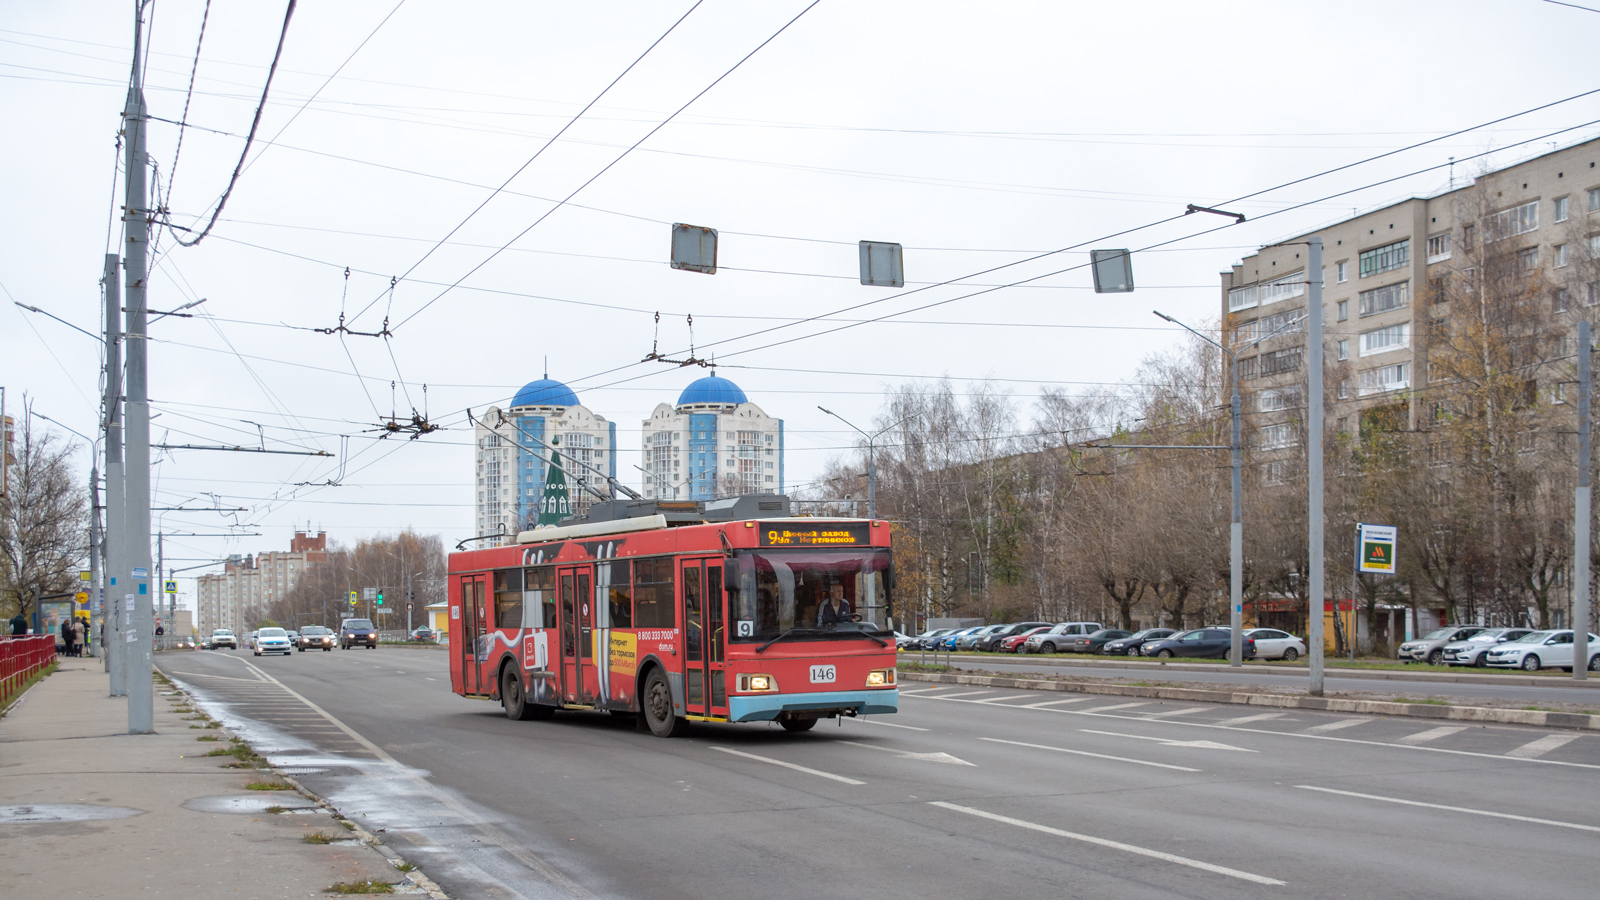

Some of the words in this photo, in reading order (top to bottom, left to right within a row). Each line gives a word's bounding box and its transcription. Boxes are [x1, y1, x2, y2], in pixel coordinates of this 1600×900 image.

[768, 530, 777, 545] 9
[638, 631, 641, 640] 8
[642, 631, 651, 640] 800
[652, 631, 660, 640] 333
[661, 630, 673, 639] 7000
[741, 623, 750, 636] 9
[812, 668, 834, 680] 146
